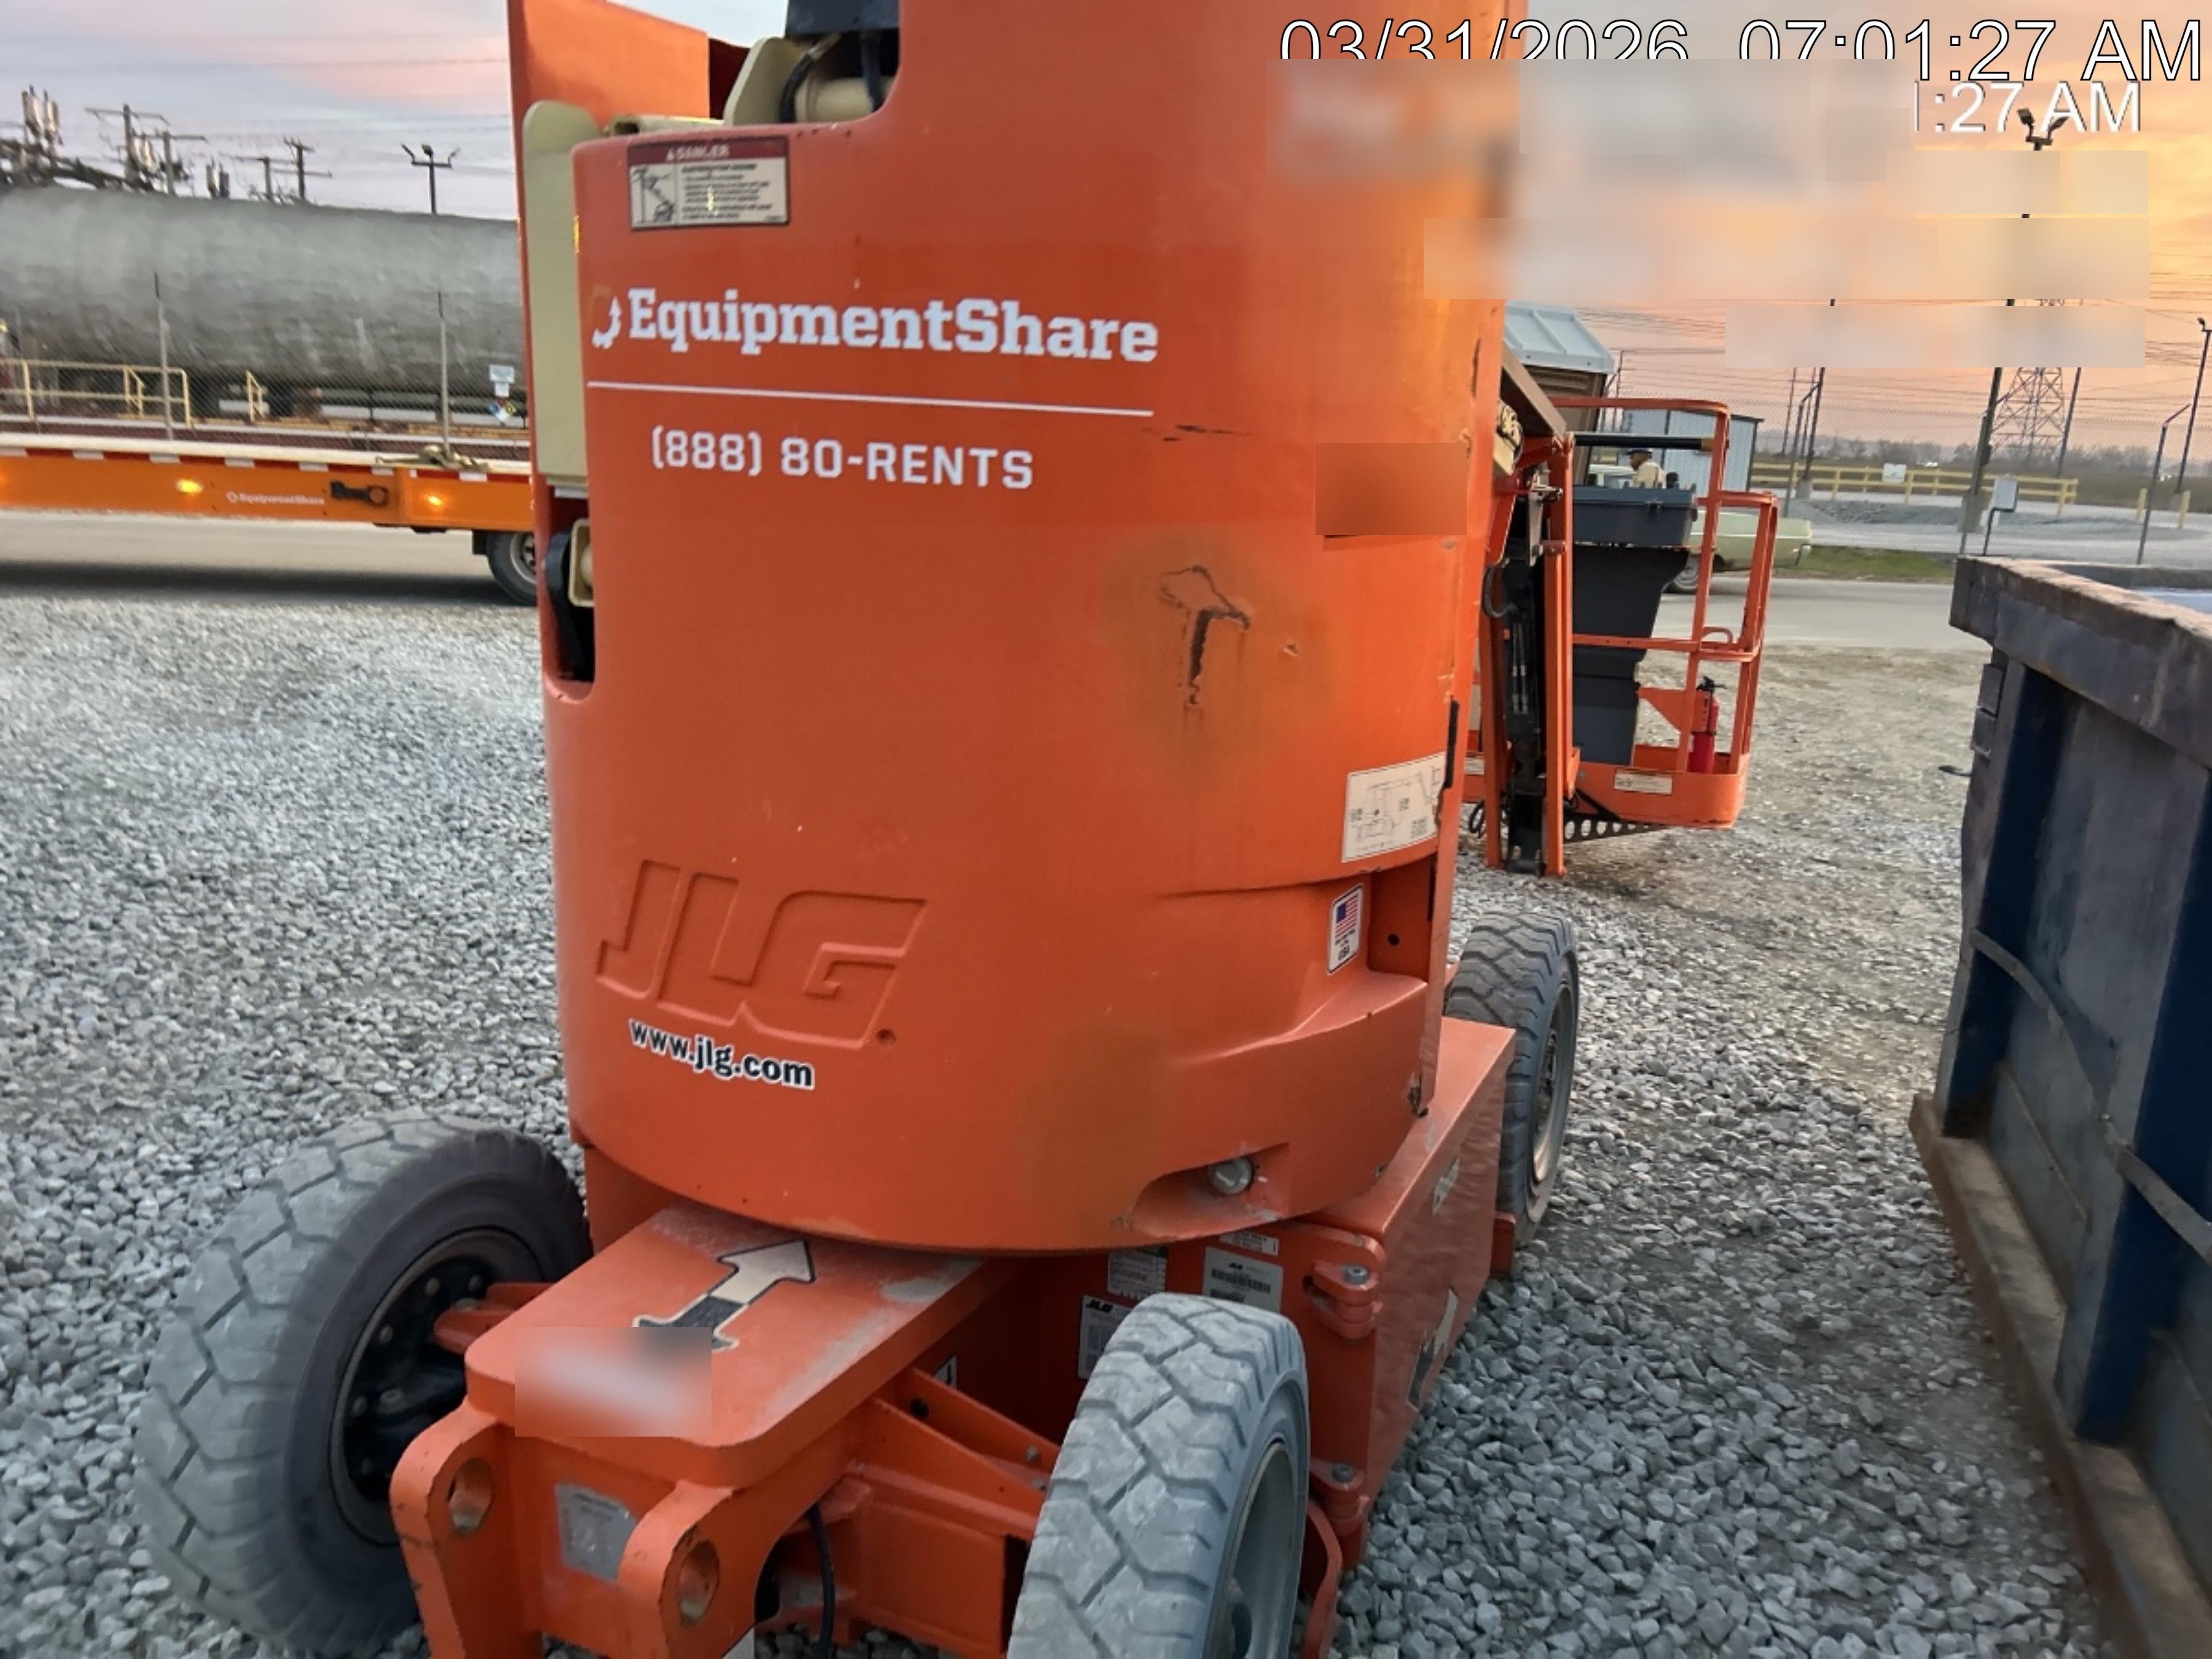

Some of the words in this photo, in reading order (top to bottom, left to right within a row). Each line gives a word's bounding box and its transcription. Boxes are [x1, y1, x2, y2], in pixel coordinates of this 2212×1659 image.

[628, 288, 1159, 363] EquipmentShare
[651, 425, 762, 477] (888)
[781, 437, 1033, 490] 80-RENTS
[595, 860, 927, 1049] JLG
[629, 1019, 815, 1089] www.jlg.com
